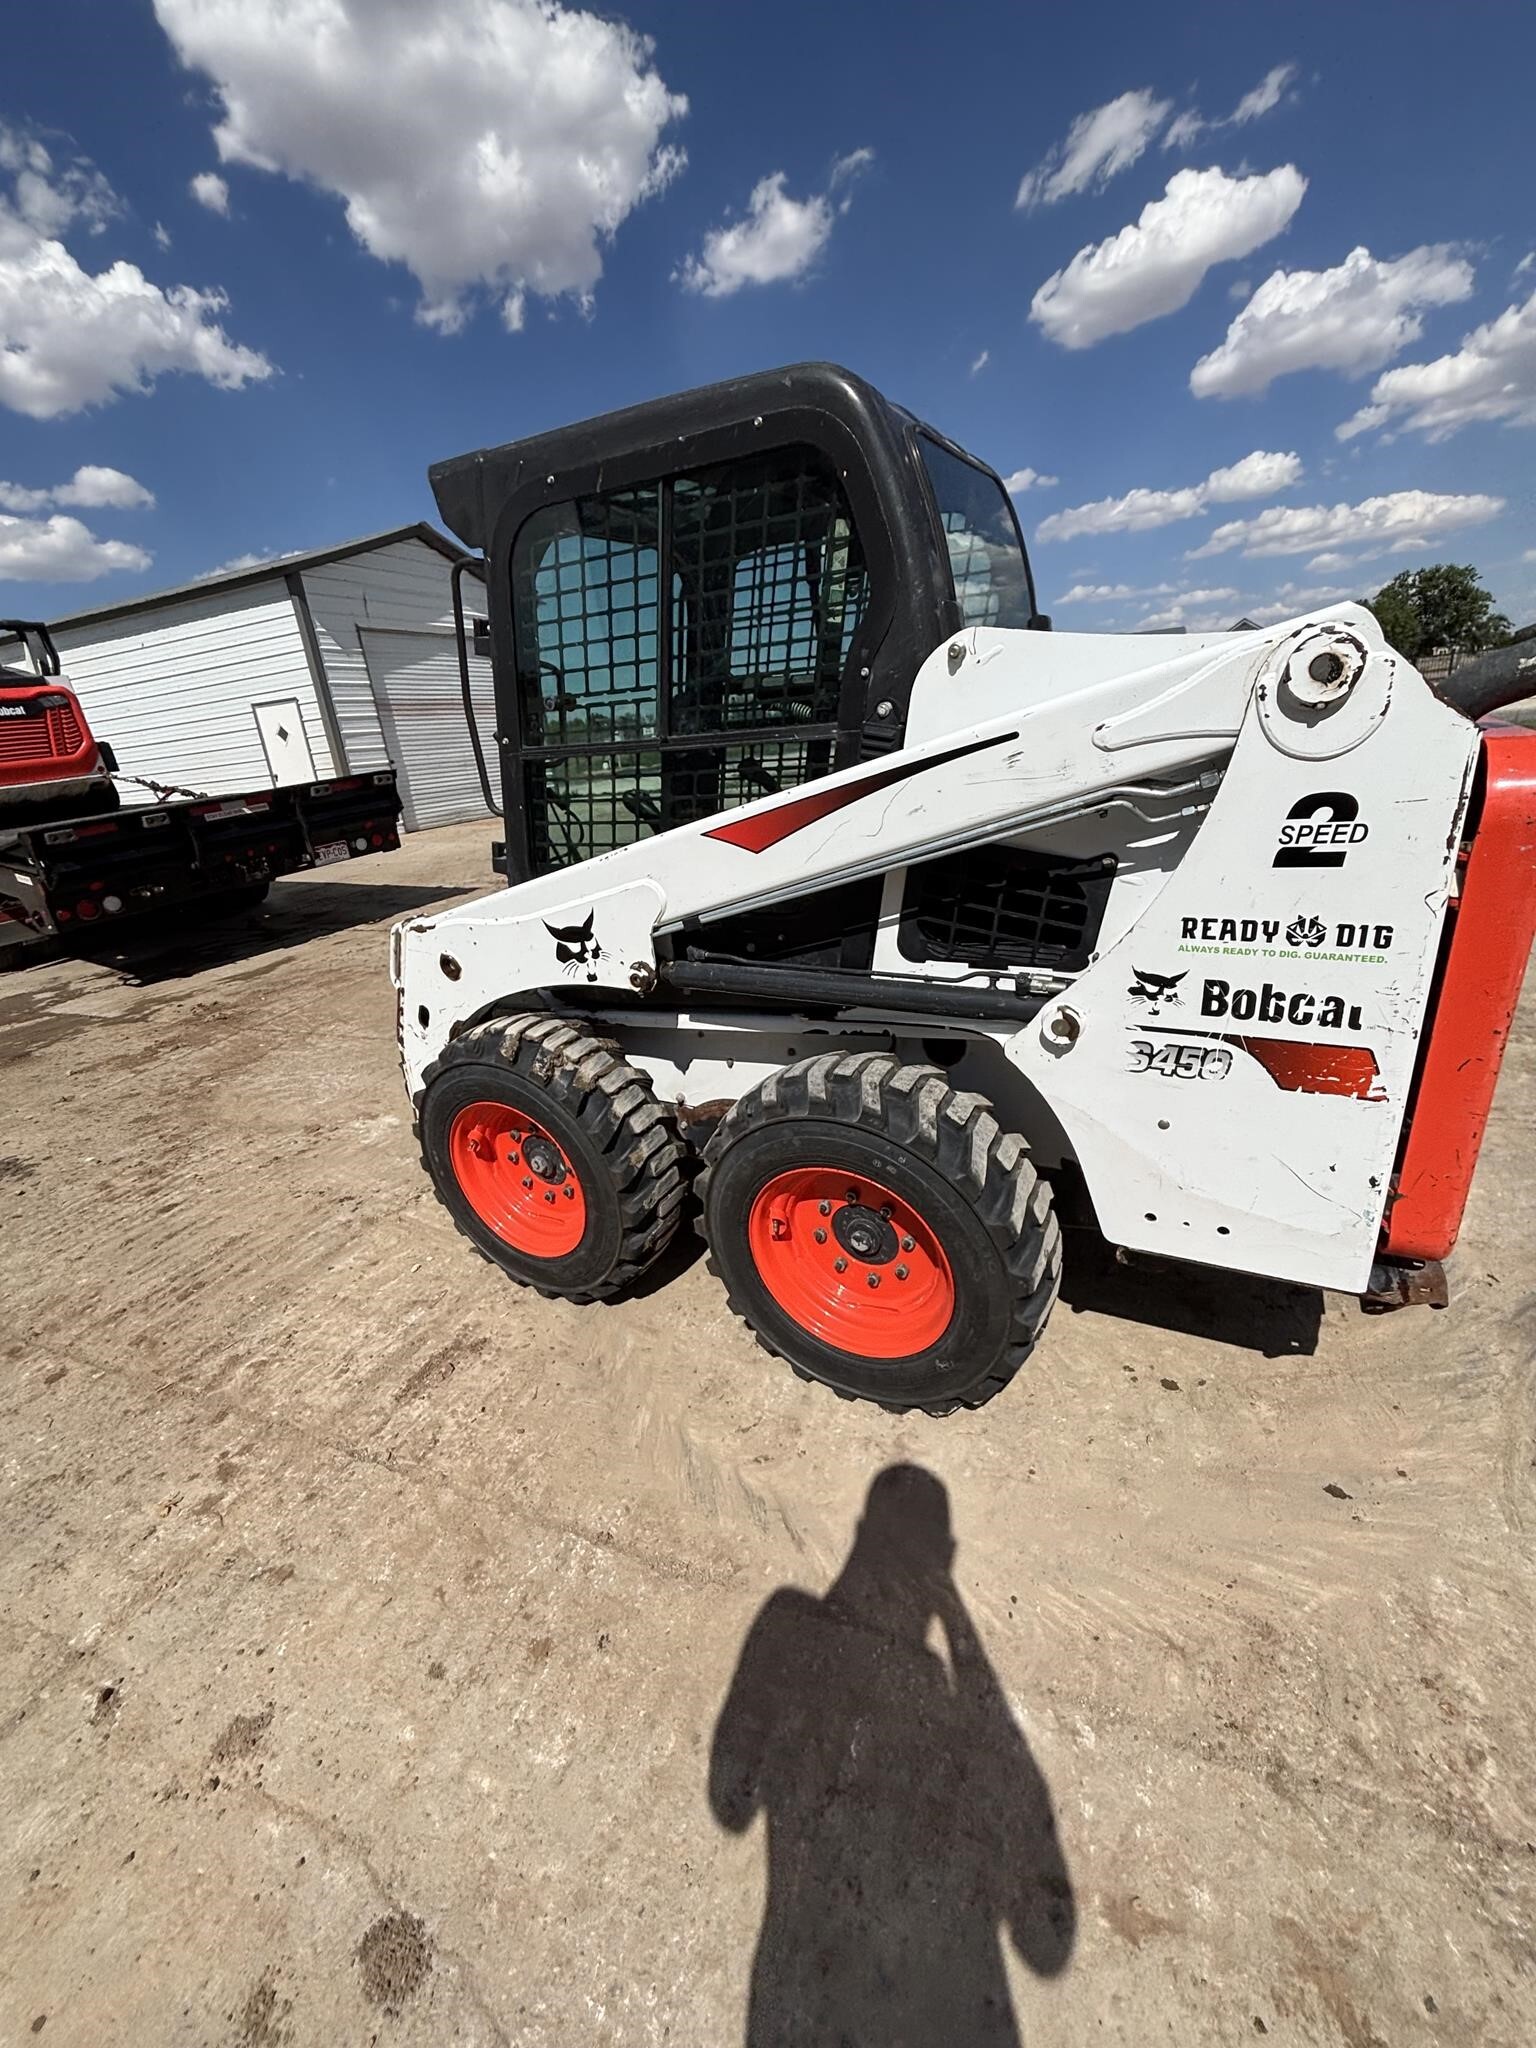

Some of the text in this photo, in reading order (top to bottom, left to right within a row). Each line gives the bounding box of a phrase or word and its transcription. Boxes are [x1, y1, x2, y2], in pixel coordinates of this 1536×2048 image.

[0, 706, 26, 716] obcat
[1272, 792, 1359, 868] 2
[1278, 823, 1369, 845] SPEED
[1181, 917, 1394, 949] READY DIG
[1178, 944, 1388, 964] ALWAYS READY TO DIG. GUARANTEED.
[1124, 1041, 1233, 1080] S450
